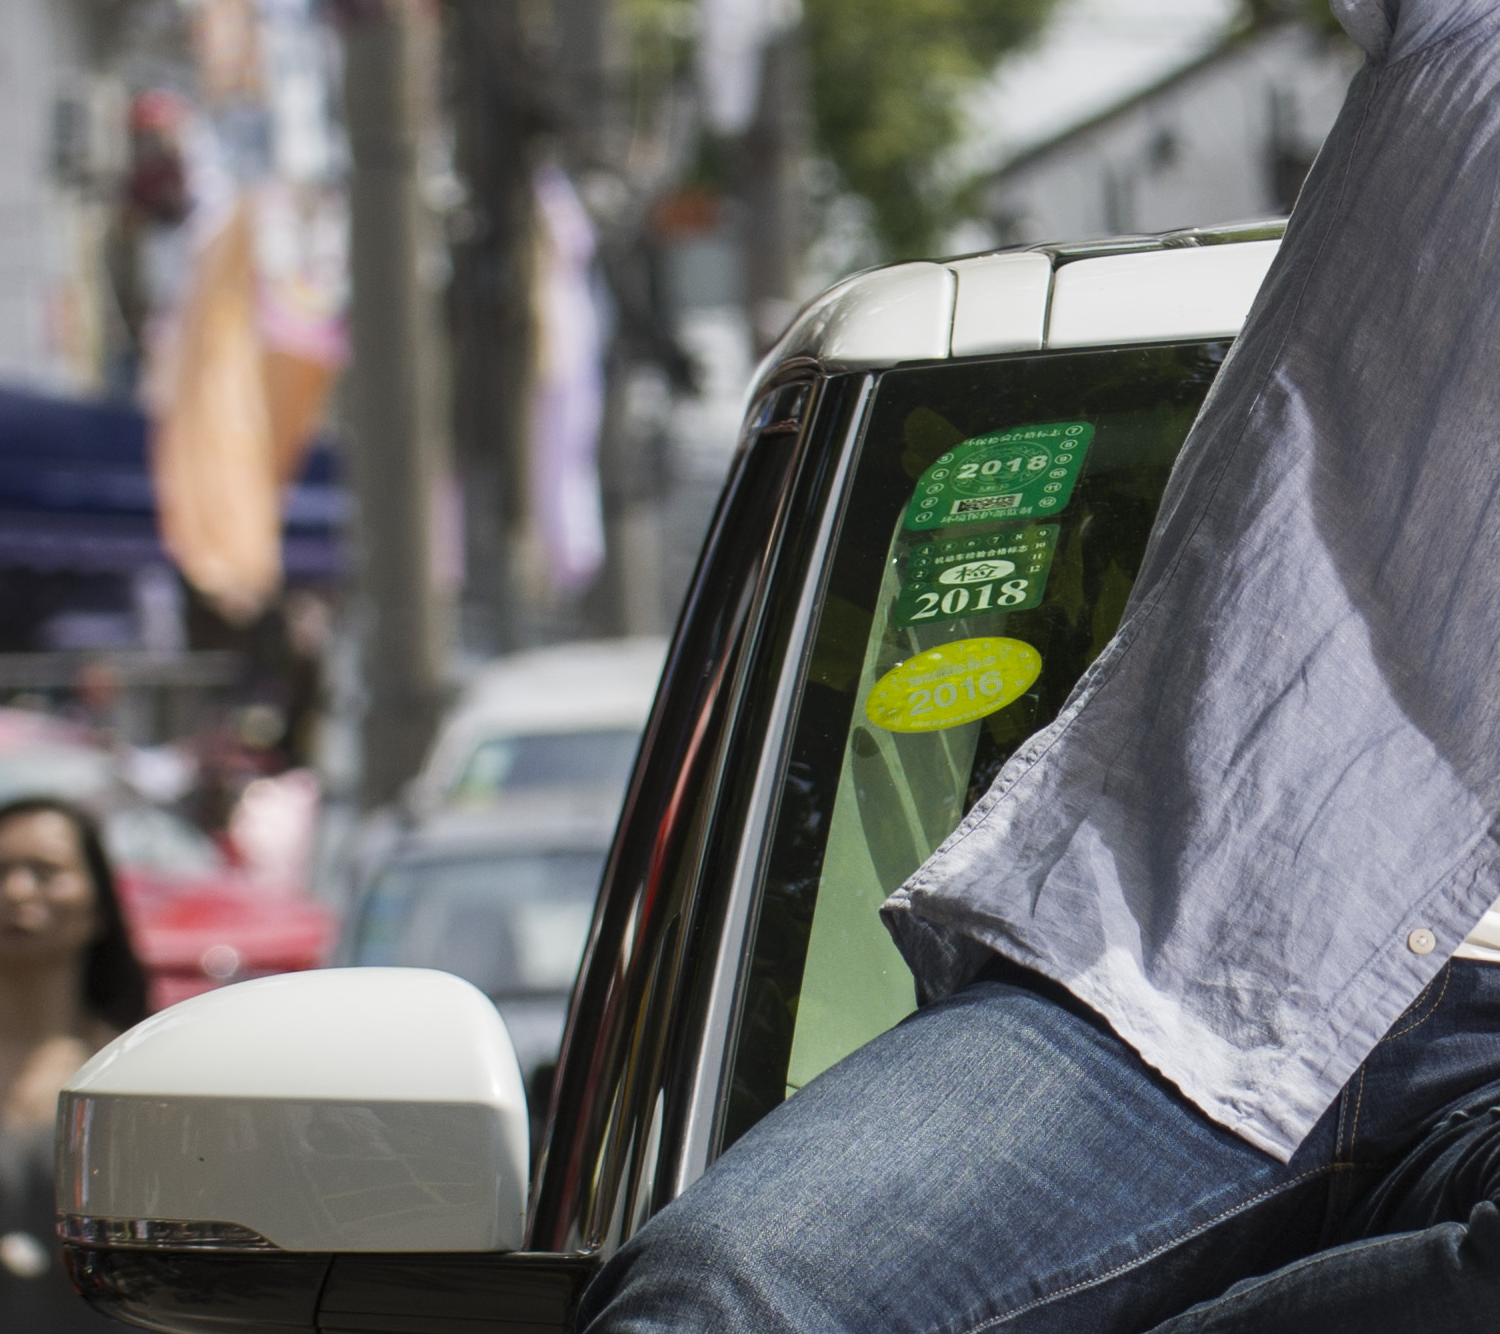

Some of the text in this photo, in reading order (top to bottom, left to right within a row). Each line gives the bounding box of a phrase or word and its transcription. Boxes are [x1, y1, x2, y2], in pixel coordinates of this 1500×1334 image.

[956, 455, 1048, 479] 2018
[954, 563, 1000, 582] 检
[909, 579, 1029, 621] 2018
[908, 670, 1003, 716] 2016
